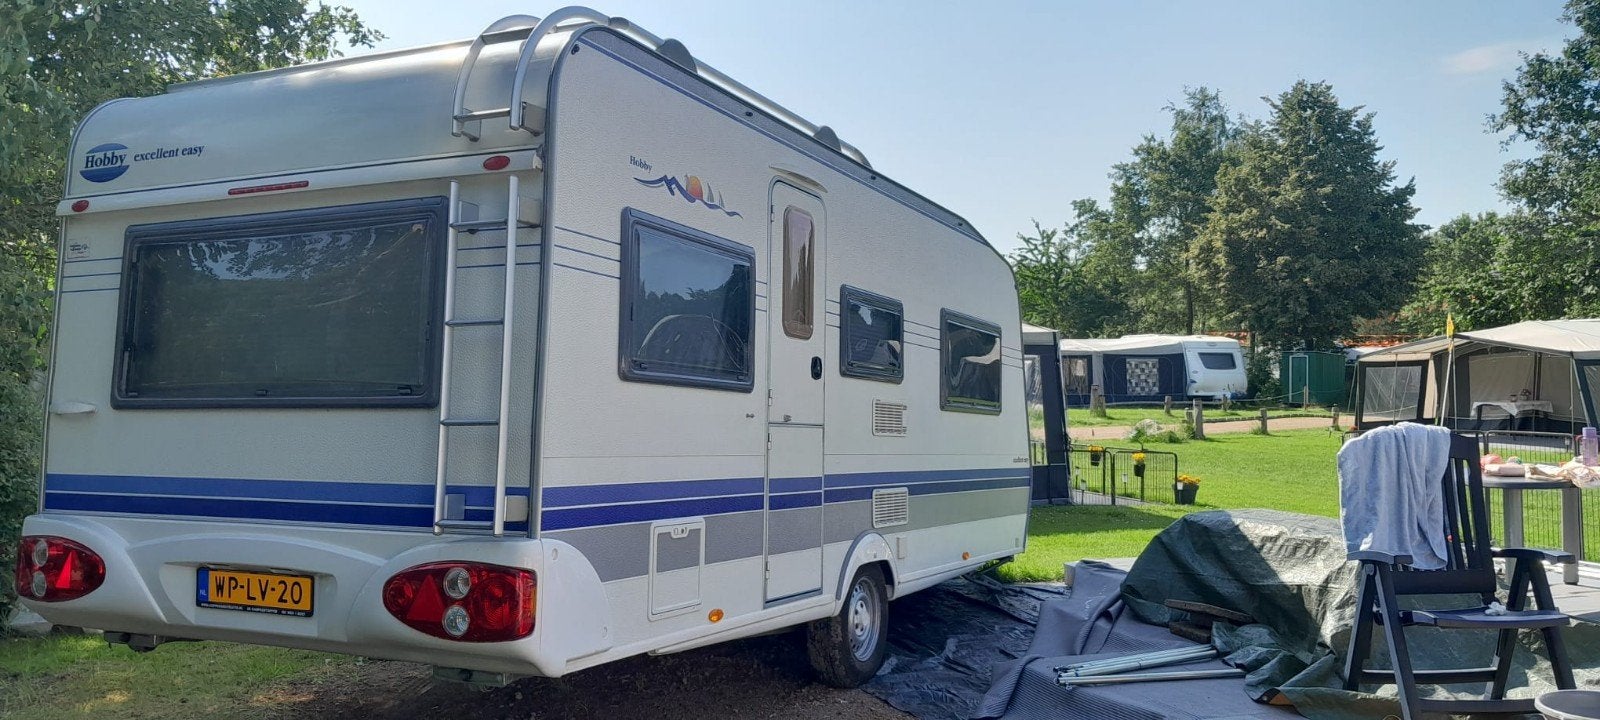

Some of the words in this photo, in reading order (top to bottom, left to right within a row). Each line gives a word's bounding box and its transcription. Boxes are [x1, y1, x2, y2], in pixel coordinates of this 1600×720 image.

[84, 151, 126, 169] Hobby
[134, 147, 179, 162] excellent
[181, 145, 205, 157] easy
[630, 155, 652, 173] Hobby
[214, 575, 303, 605] WP-LV-20
